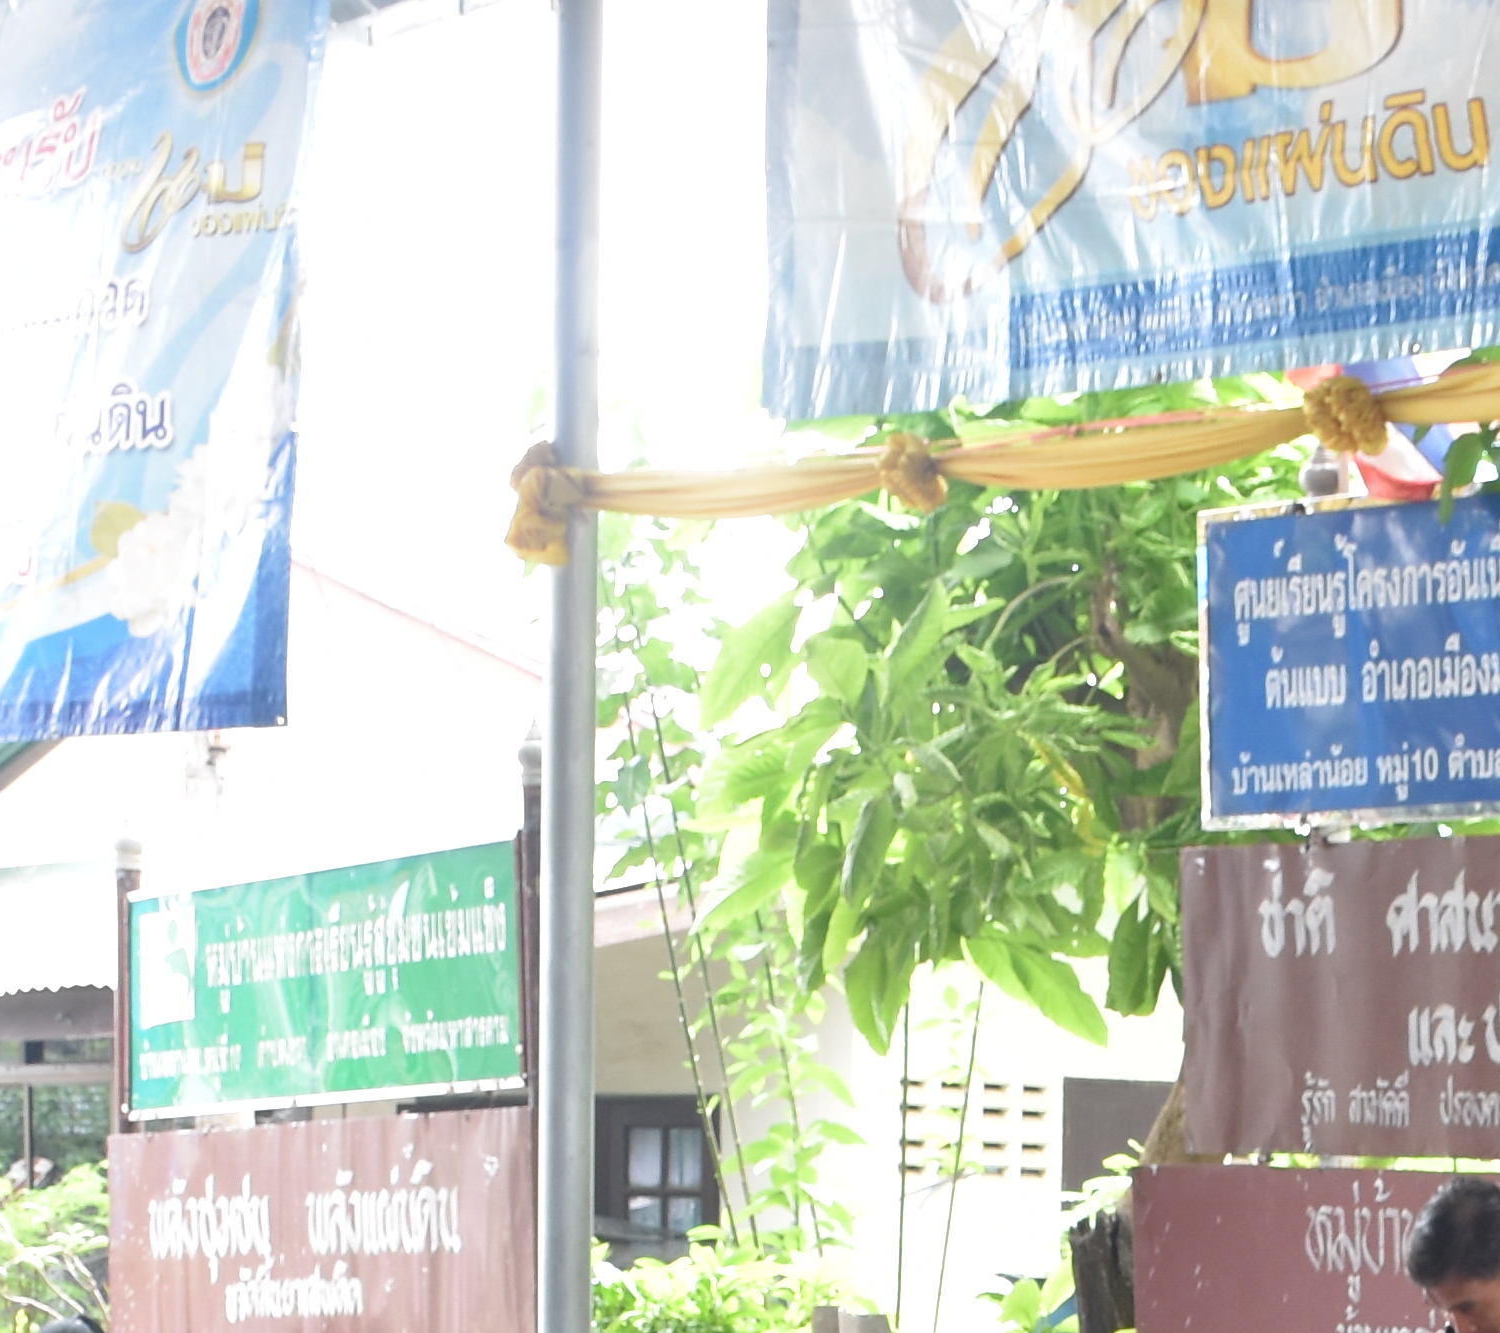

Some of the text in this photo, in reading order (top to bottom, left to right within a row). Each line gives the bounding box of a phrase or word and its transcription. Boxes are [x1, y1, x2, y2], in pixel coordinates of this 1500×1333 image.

[1128, 88, 1490, 222] ของแผ่นดิน
[1265, 646, 1347, 709] ต้นแบบ
[1232, 744, 1368, 795] บ้านเหล่าน้อย
[1258, 869, 1337, 959] ชาติ
[1407, 1003, 1476, 1067] และ
[1349, 1069, 1411, 1128] สามัคคี
[1304, 1177, 1414, 1303] หมู่บ้า
